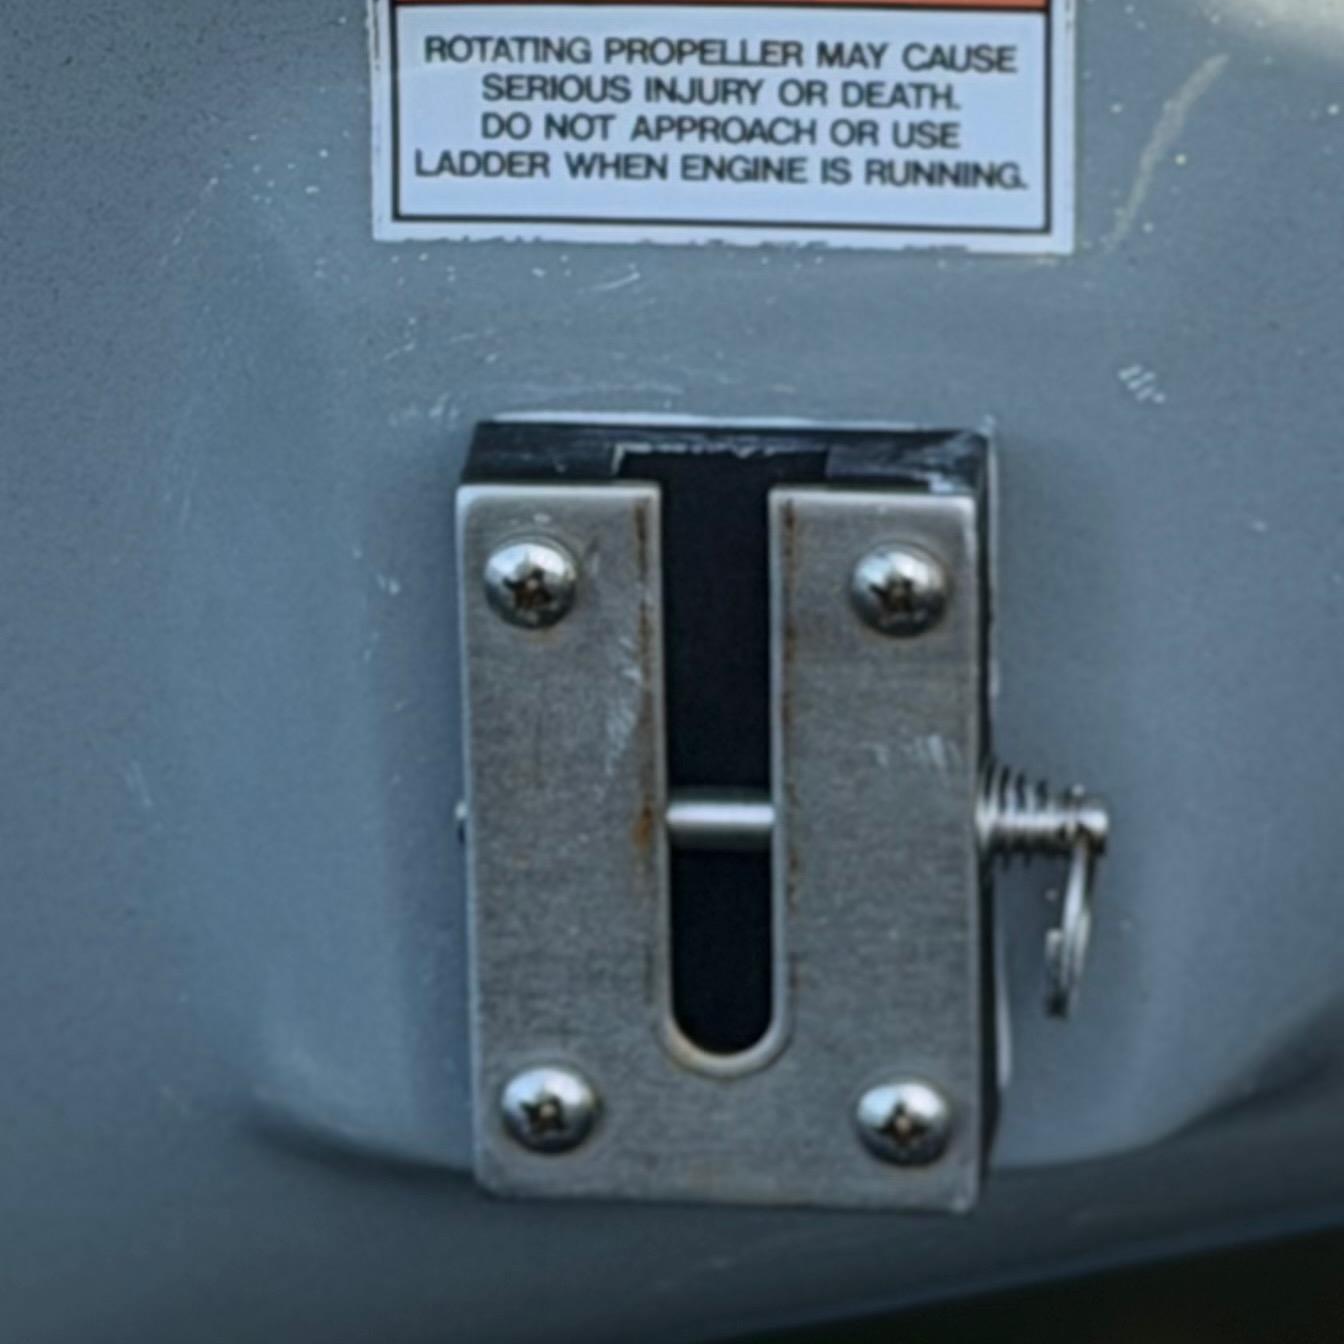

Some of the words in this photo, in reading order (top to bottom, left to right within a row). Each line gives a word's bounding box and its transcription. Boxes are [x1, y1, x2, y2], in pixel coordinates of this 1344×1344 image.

[424, 36, 592, 66] ROTATING
[604, 39, 803, 69] PROPELLER
[816, 42, 889, 69] MAY
[902, 44, 1018, 73] CAUSE
[482, 75, 631, 103] SERIOUS
[644, 78, 764, 106] INJURY
[778, 80, 827, 107] OR
[841, 82, 961, 110] DEATH.
[482, 113, 530, 141] DO
[544, 115, 617, 142] NOT
[630, 116, 816, 146] APPROACH
[830, 119, 879, 147] OR
[892, 120, 960, 148] USE
[415, 150, 550, 178] LADDER
[567, 153, 668, 180] WHEN
[681, 156, 807, 183] ENGINE
[820, 158, 851, 185] IS
[865, 159, 1028, 189] RUNNING.
